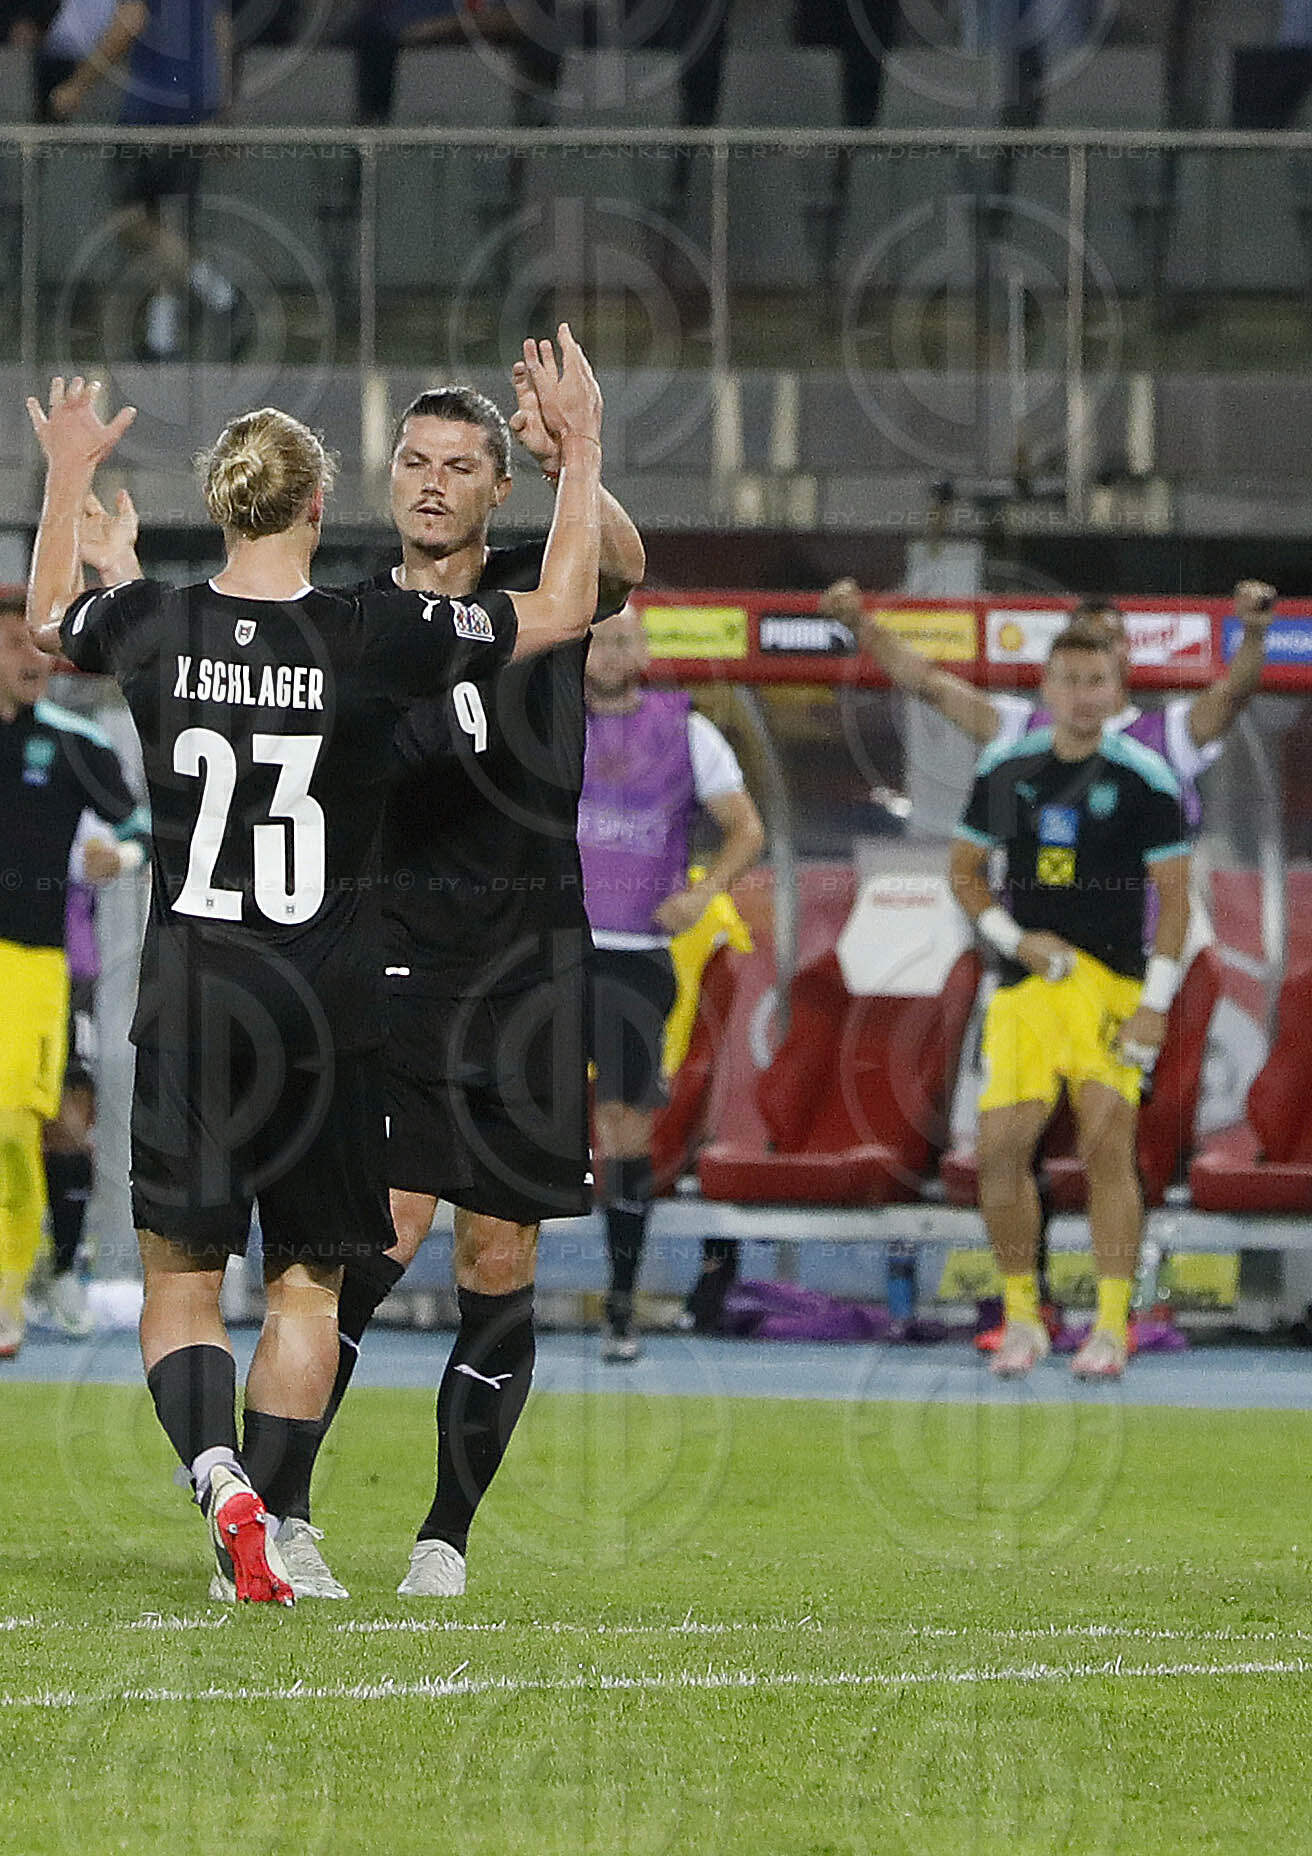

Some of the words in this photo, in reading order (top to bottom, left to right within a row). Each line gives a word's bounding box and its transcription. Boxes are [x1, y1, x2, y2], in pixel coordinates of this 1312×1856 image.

[174, 655, 324, 710] X.SCHLAGER
[452, 681, 488, 753] 9
[171, 727, 325, 925] 23
